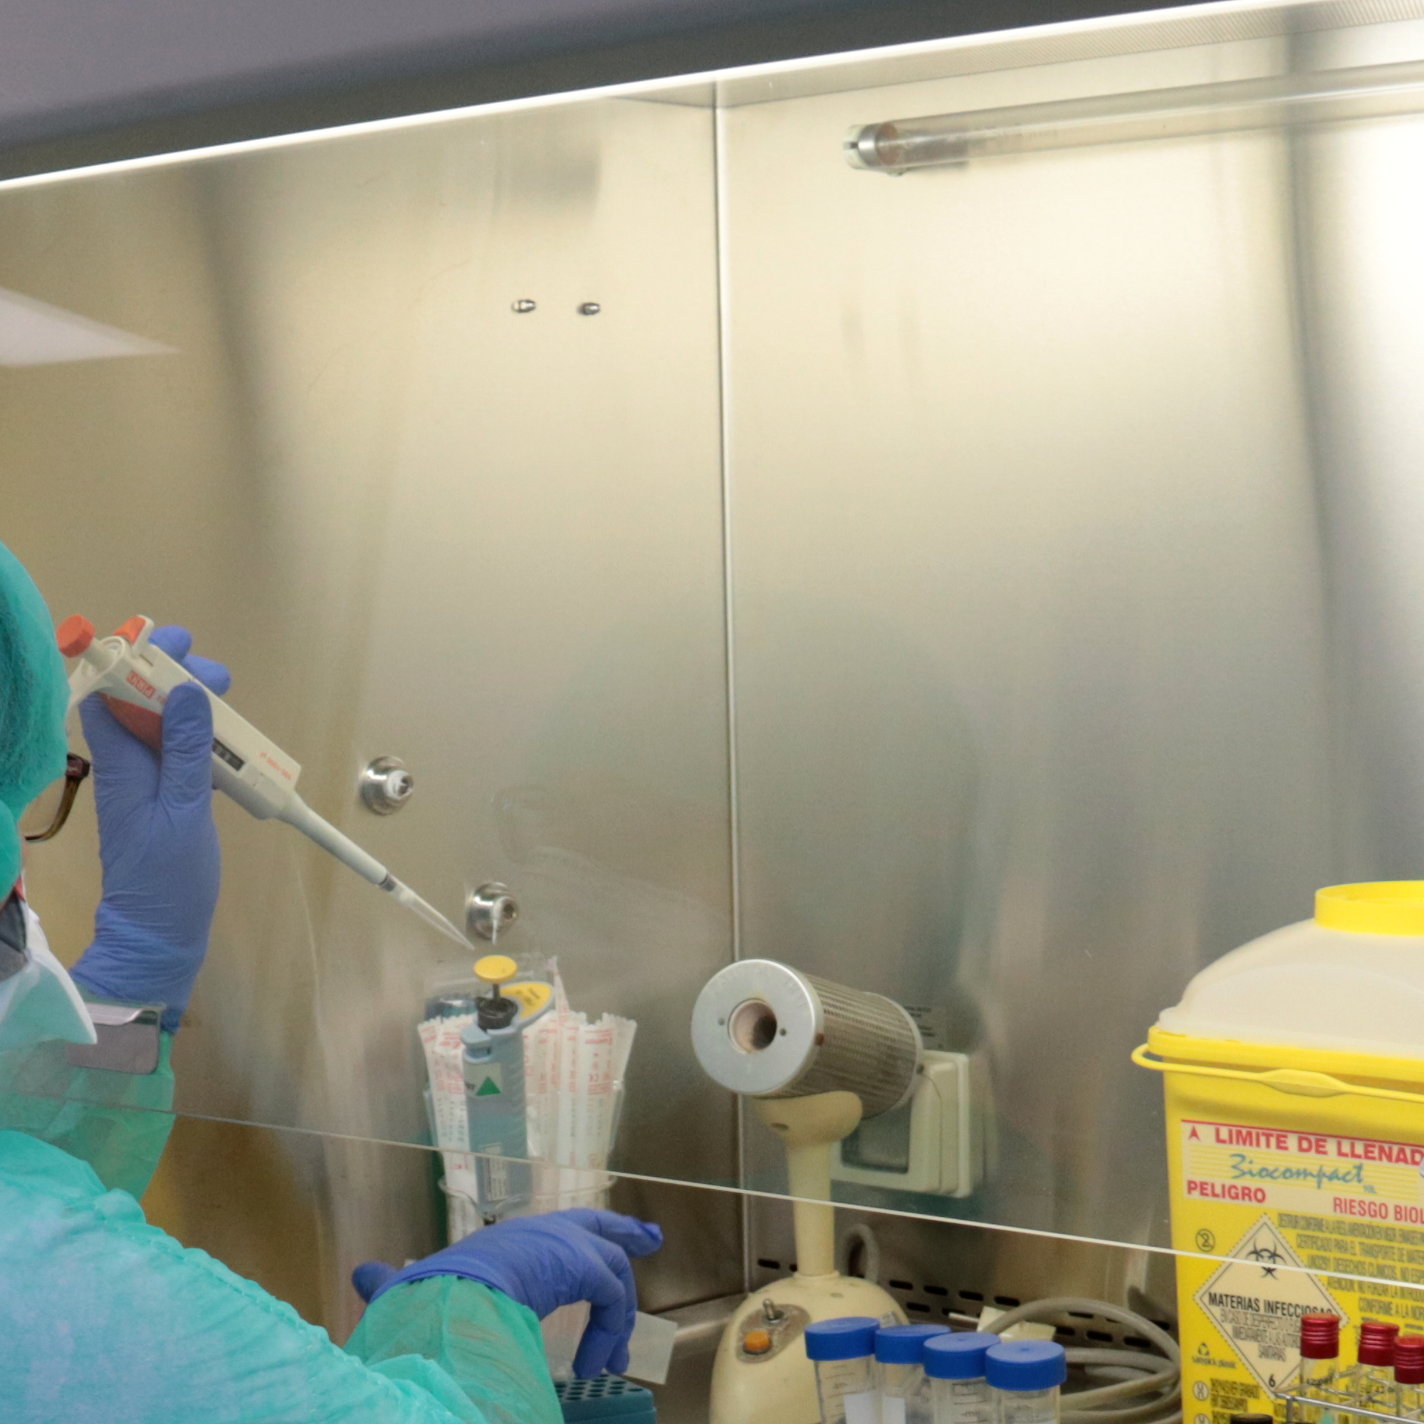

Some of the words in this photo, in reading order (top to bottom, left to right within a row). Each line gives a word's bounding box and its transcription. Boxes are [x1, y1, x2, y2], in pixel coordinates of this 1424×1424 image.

[1214, 1127, 1289, 1151] LIMITE
[1297, 1136, 1328, 1156] DE
[1336, 1140, 1424, 1166] LLENAD
[1187, 1180, 1266, 1204] PELIGRO
[1333, 1197, 1388, 1220] RIESGO
[1208, 1292, 1260, 1312] MATERIAS
[1268, 1373, 1276, 1388] 6
